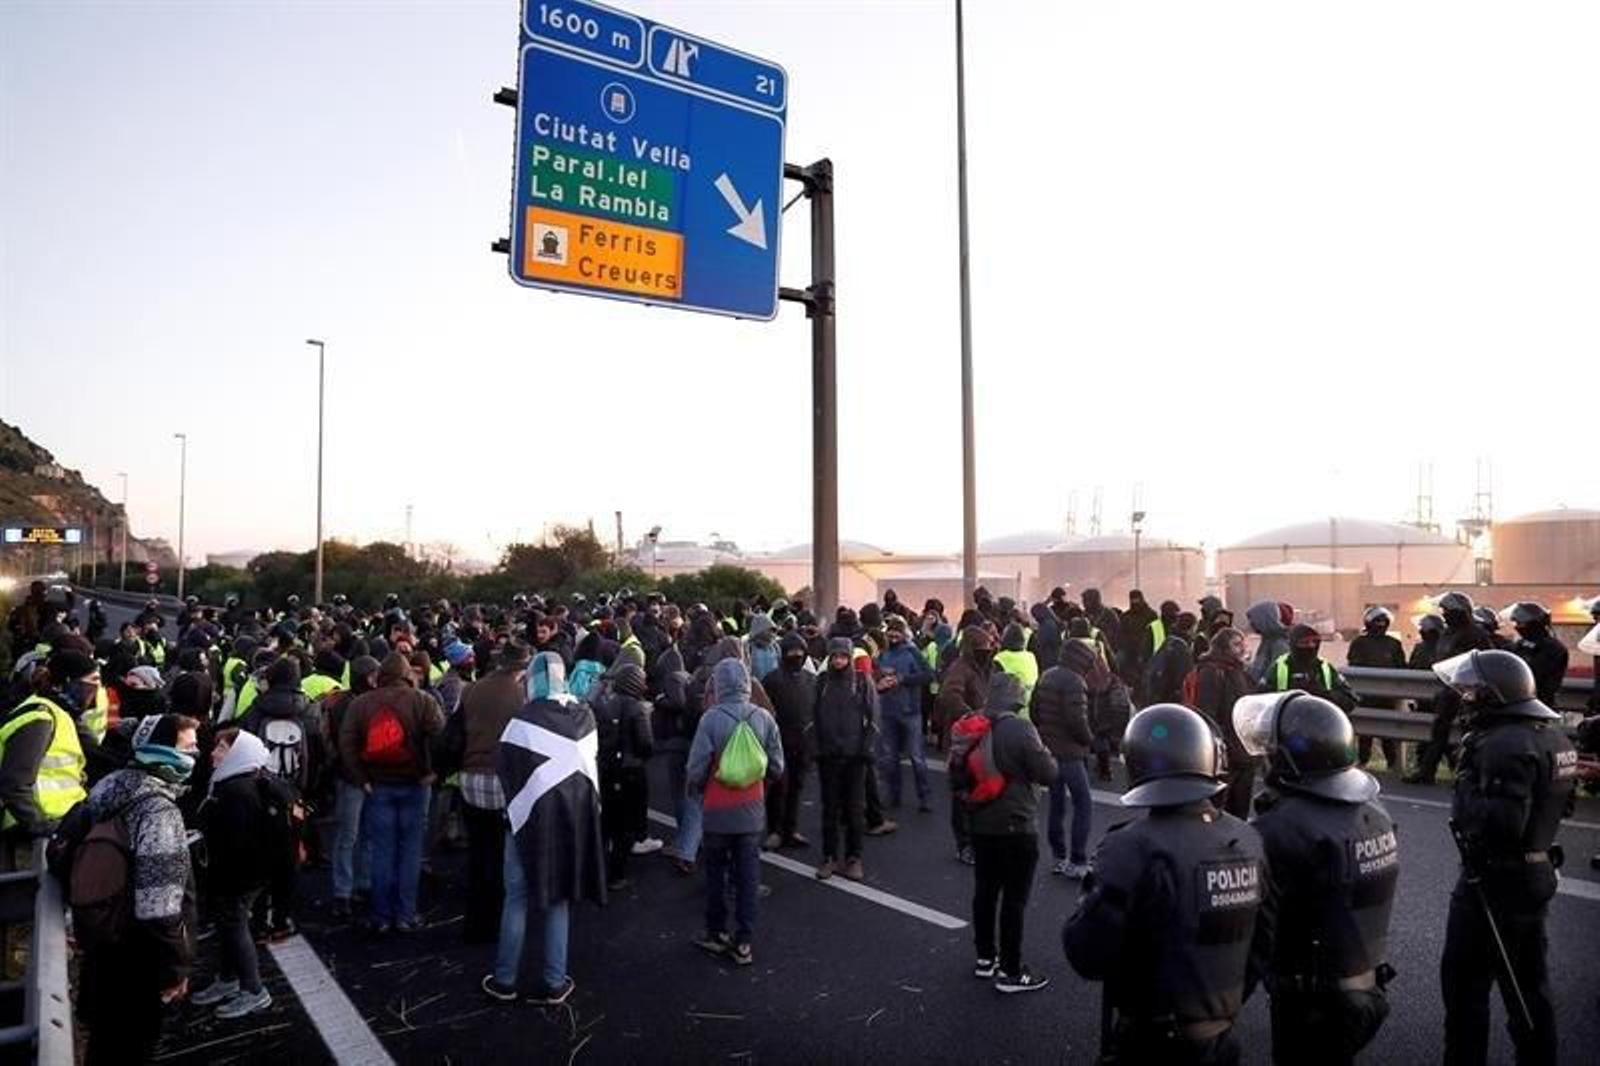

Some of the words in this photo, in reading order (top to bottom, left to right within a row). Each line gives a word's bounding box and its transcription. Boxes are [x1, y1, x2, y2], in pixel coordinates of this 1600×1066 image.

[541, 4, 599, 39] 1600
[612, 31, 631, 50] m
[755, 75, 775, 96] 21
[534, 113, 617, 152] Ciutat
[632, 136, 691, 170] Vella
[532, 145, 647, 190] Paral.lel
[531, 175, 563, 202] La
[579, 185, 669, 222] Rambla
[579, 223, 657, 256] Ferris
[579, 256, 677, 290] Creuers
